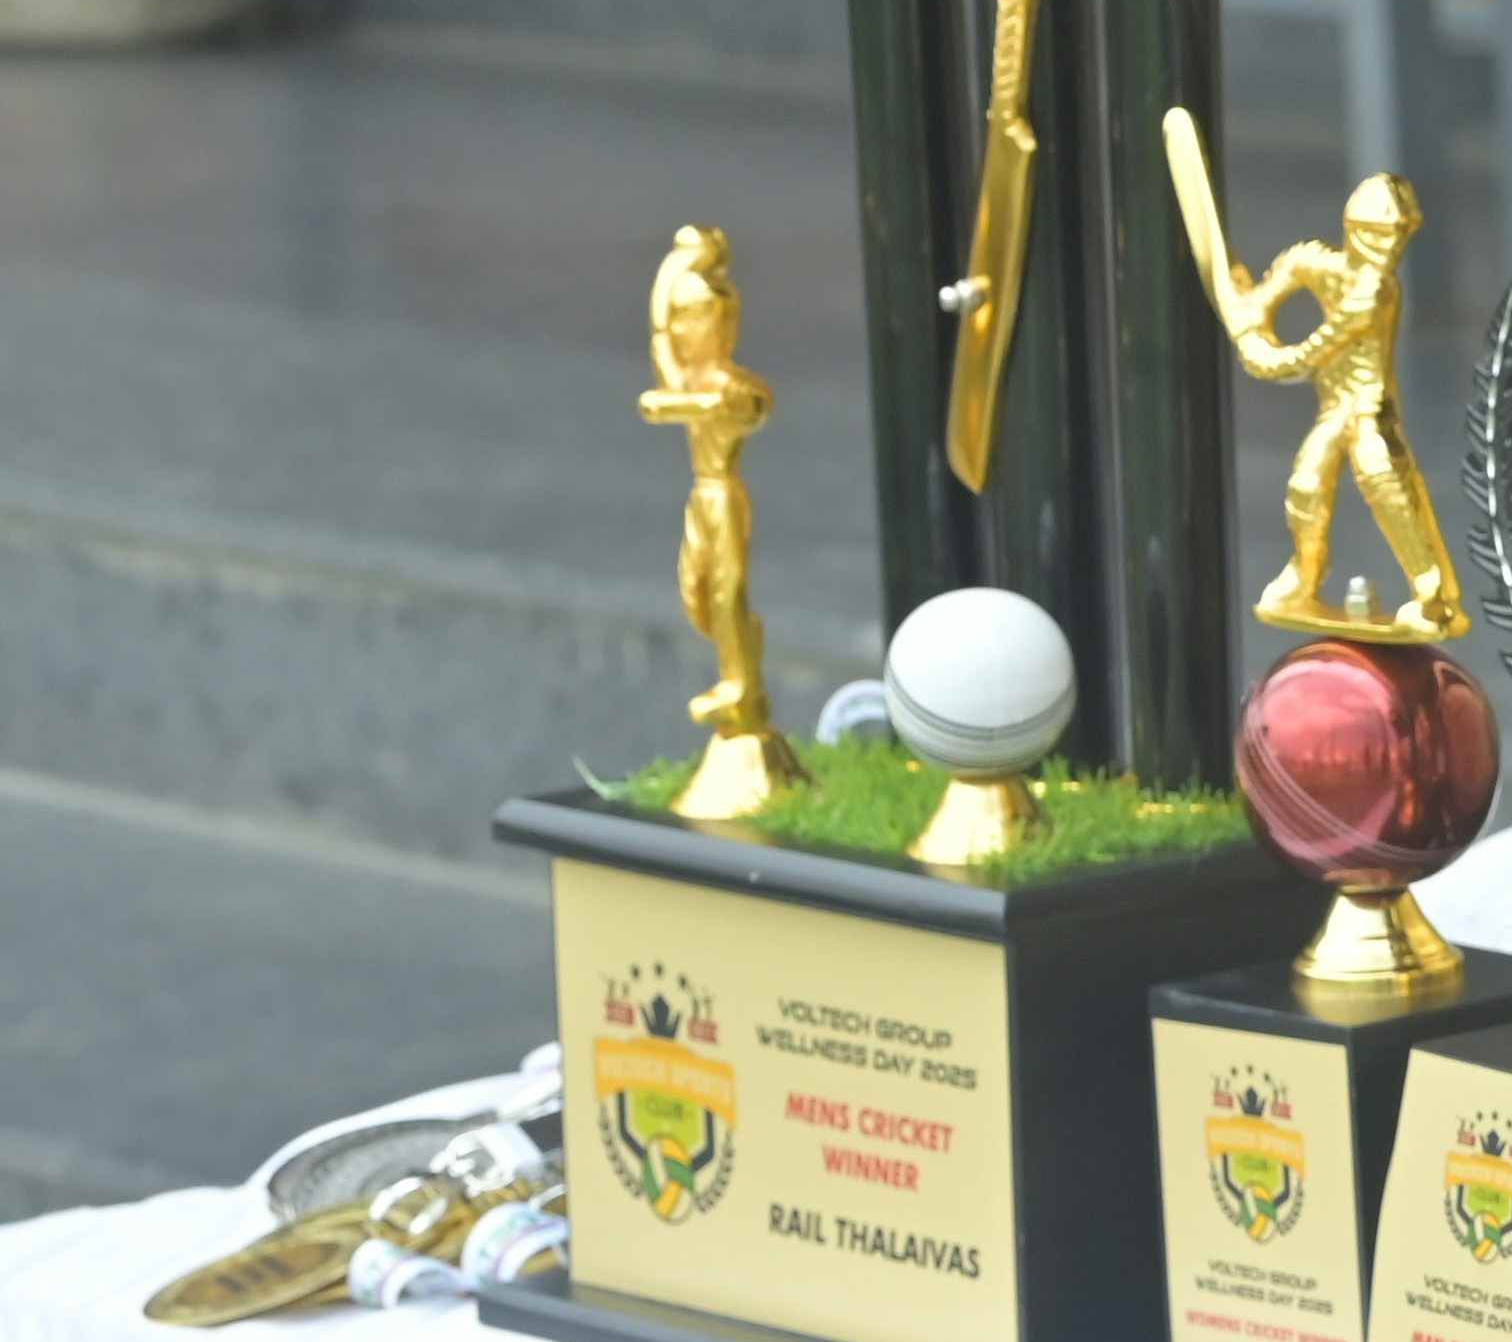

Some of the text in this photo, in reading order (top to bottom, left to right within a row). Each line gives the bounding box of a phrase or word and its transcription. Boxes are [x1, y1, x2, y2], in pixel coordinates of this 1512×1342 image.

[777, 997, 953, 1050] VOLTECH GROUP
[755, 1025, 979, 1089] WELLNESS DAY 2025
[785, 1091, 954, 1152] MENS CRICKET
[822, 1145, 920, 1191] WINNER
[768, 1203, 980, 1279] RAIL THALAIVAS
[1405, 1290, 1484, 1326] WELLNESS
[1424, 1273, 1489, 1303] VOLTECH
